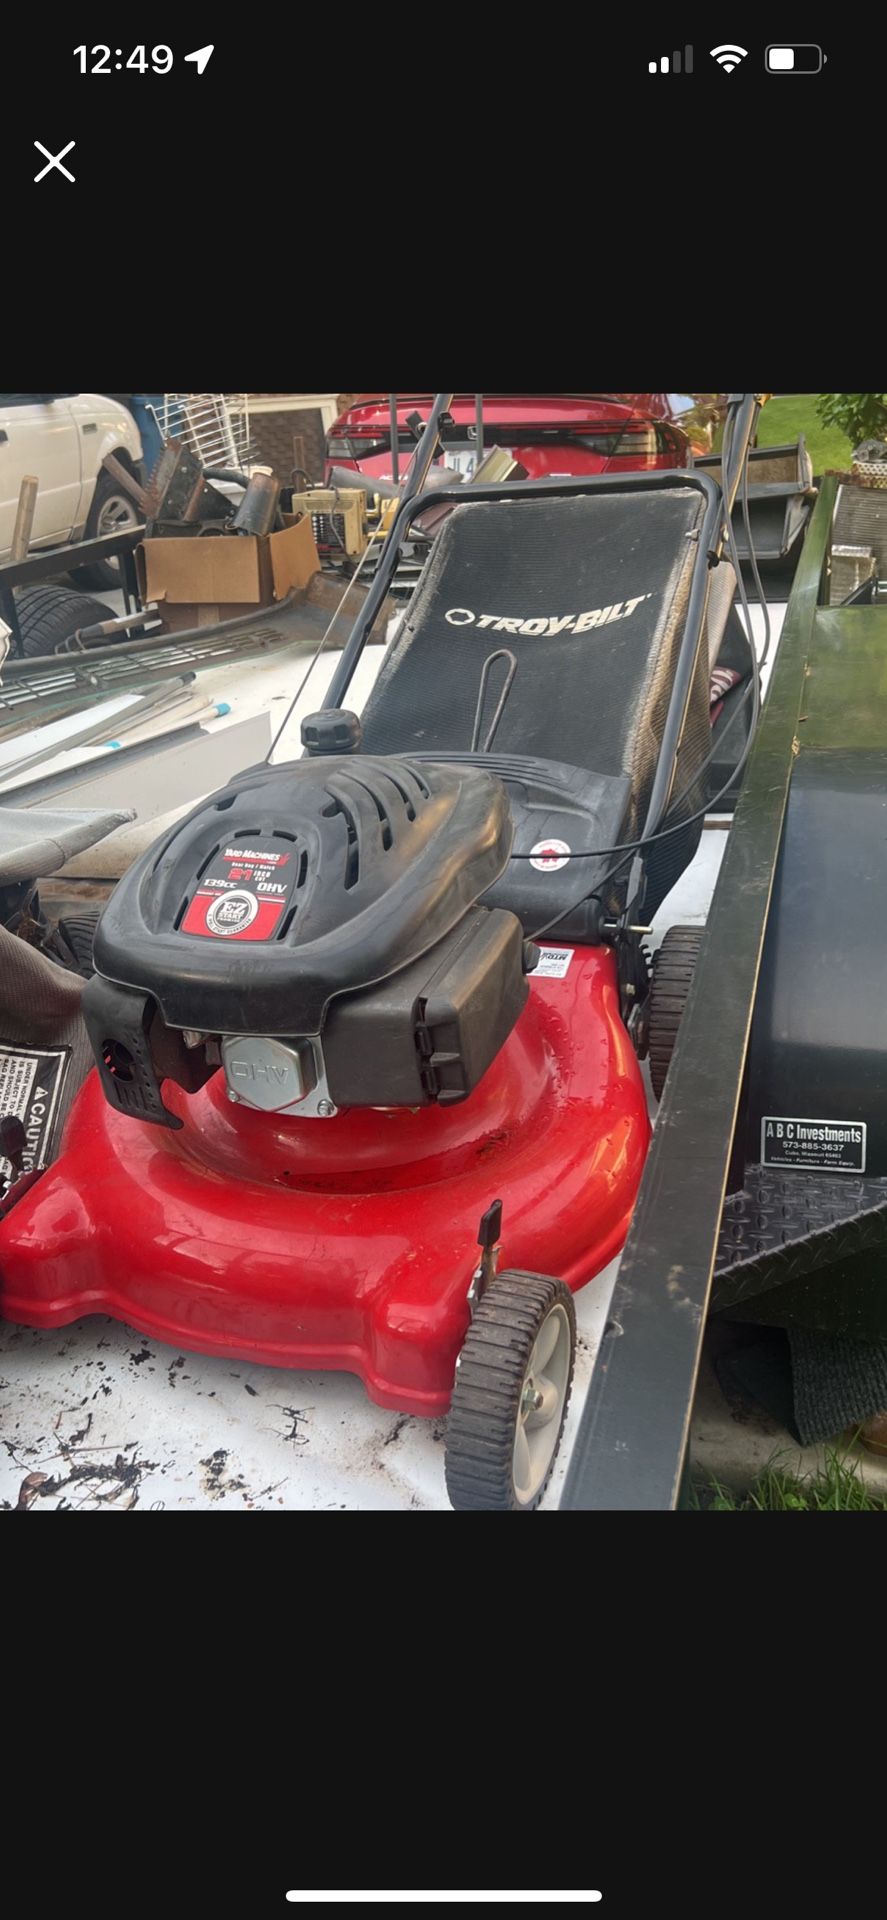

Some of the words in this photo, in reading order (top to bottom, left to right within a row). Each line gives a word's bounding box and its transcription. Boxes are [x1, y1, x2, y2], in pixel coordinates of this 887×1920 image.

[475, 593, 647, 637] TROY-BILT
[203, 878, 238, 888] 139cc
[228, 868, 254, 881] 21
[256, 882, 288, 893] OHV
[220, 901, 249, 914] EZ
[9, 1060, 17, 1074] AND
[23, 1062, 33, 1084] UNDER
[230, 1059, 289, 1086] OHV
[3, 1075, 14, 1101] SHOULD
[12, 1070, 24, 1098] SUBJECT
[9, 1101, 16, 1109] TO
[16, 1085, 27, 1112] NORMAL
[766, 1122, 774, 1137] A
[776, 1123, 784, 1138] B
[786, 1124, 794, 1139] C
[797, 1124, 862, 1143] Investments
[782, 1141, 845, 1151] 573-885-3637
